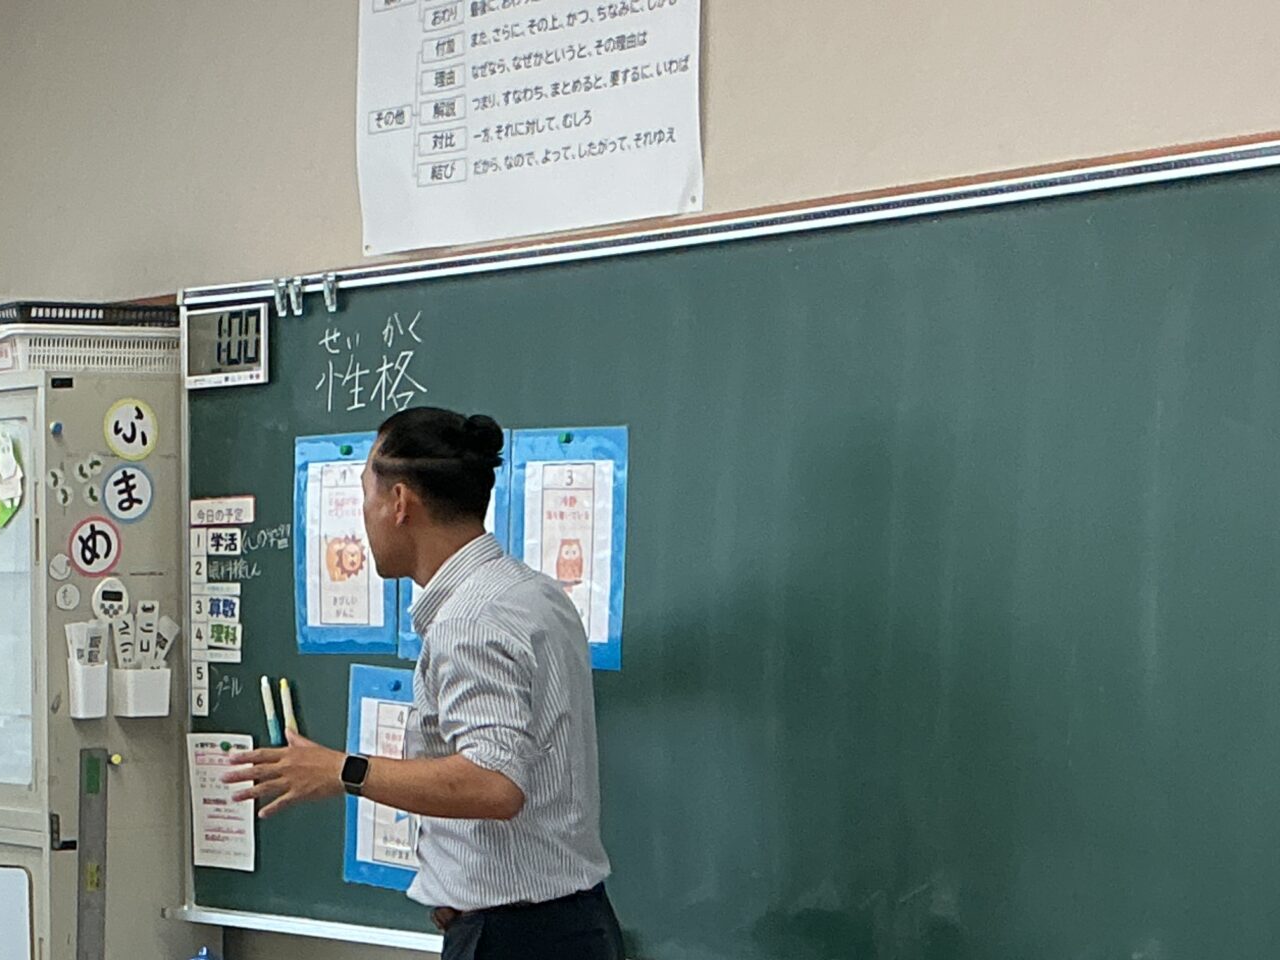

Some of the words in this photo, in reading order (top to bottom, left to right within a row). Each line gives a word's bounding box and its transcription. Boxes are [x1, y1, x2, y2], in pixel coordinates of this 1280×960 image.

[375, 109, 406, 128] その他
[432, 133, 456, 150] 対比
[318, 327, 361, 354] せい
[382, 310, 423, 348] がく
[315, 350, 428, 412] 性格
[113, 405, 148, 446] ふ
[565, 469, 574, 487] 3
[113, 469, 143, 512] ま
[78, 523, 112, 566] め
[210, 532, 238, 552] 学活
[195, 561, 202, 576] 2
[195, 601, 203, 615] 3
[208, 597, 236, 618] 算数
[195, 627, 203, 641] 4
[210, 623, 237, 645] 理科
[196, 666, 204, 681] 5
[196, 693, 204, 708] 6
[397, 710, 405, 725] 4
